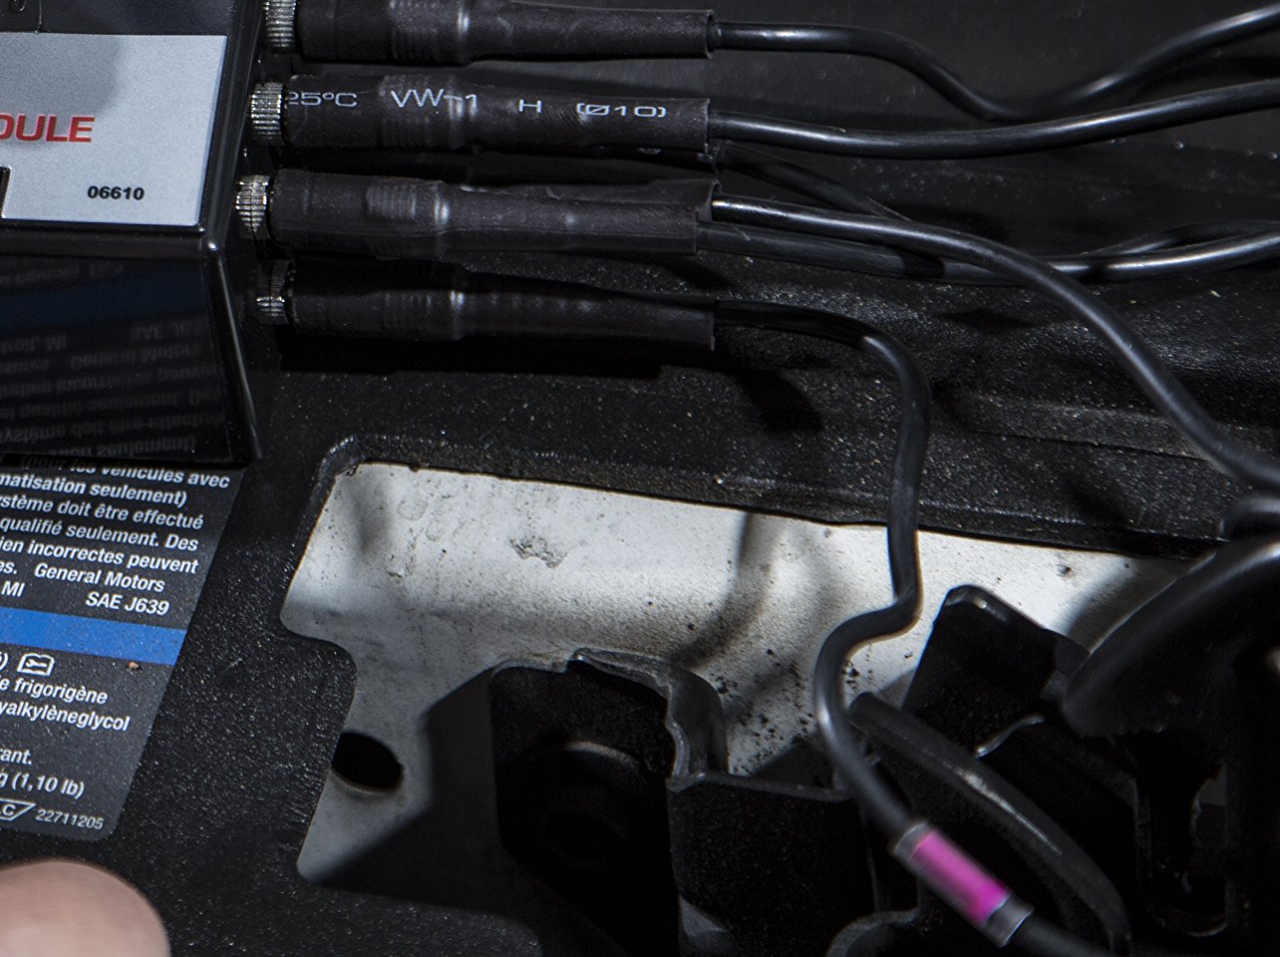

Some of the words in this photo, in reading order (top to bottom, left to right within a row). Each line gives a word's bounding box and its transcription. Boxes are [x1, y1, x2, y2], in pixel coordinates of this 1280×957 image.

[519, 99, 543, 114] H
[87, 185, 145, 201] 06610
[187, 471, 231, 490] avec
[89, 480, 188, 509] seulement)
[57, 497, 92, 516] doit
[94, 500, 130, 520] être
[132, 504, 205, 530] effectué
[0, 513, 63, 537] qualifié
[165, 533, 200, 552] Des
[27, 540, 126, 565] incorrectes
[128, 551, 199, 575] peuvent
[1, 581, 25, 597] MI
[33, 562, 101, 585] General
[105, 571, 166, 594] Motors
[85, 591, 122, 610] SAE
[124, 595, 170, 616] J639
[14, 677, 108, 706] frigorigène
[61, 776, 86, 798] lb)
[34, 809, 105, 831] 22711205
